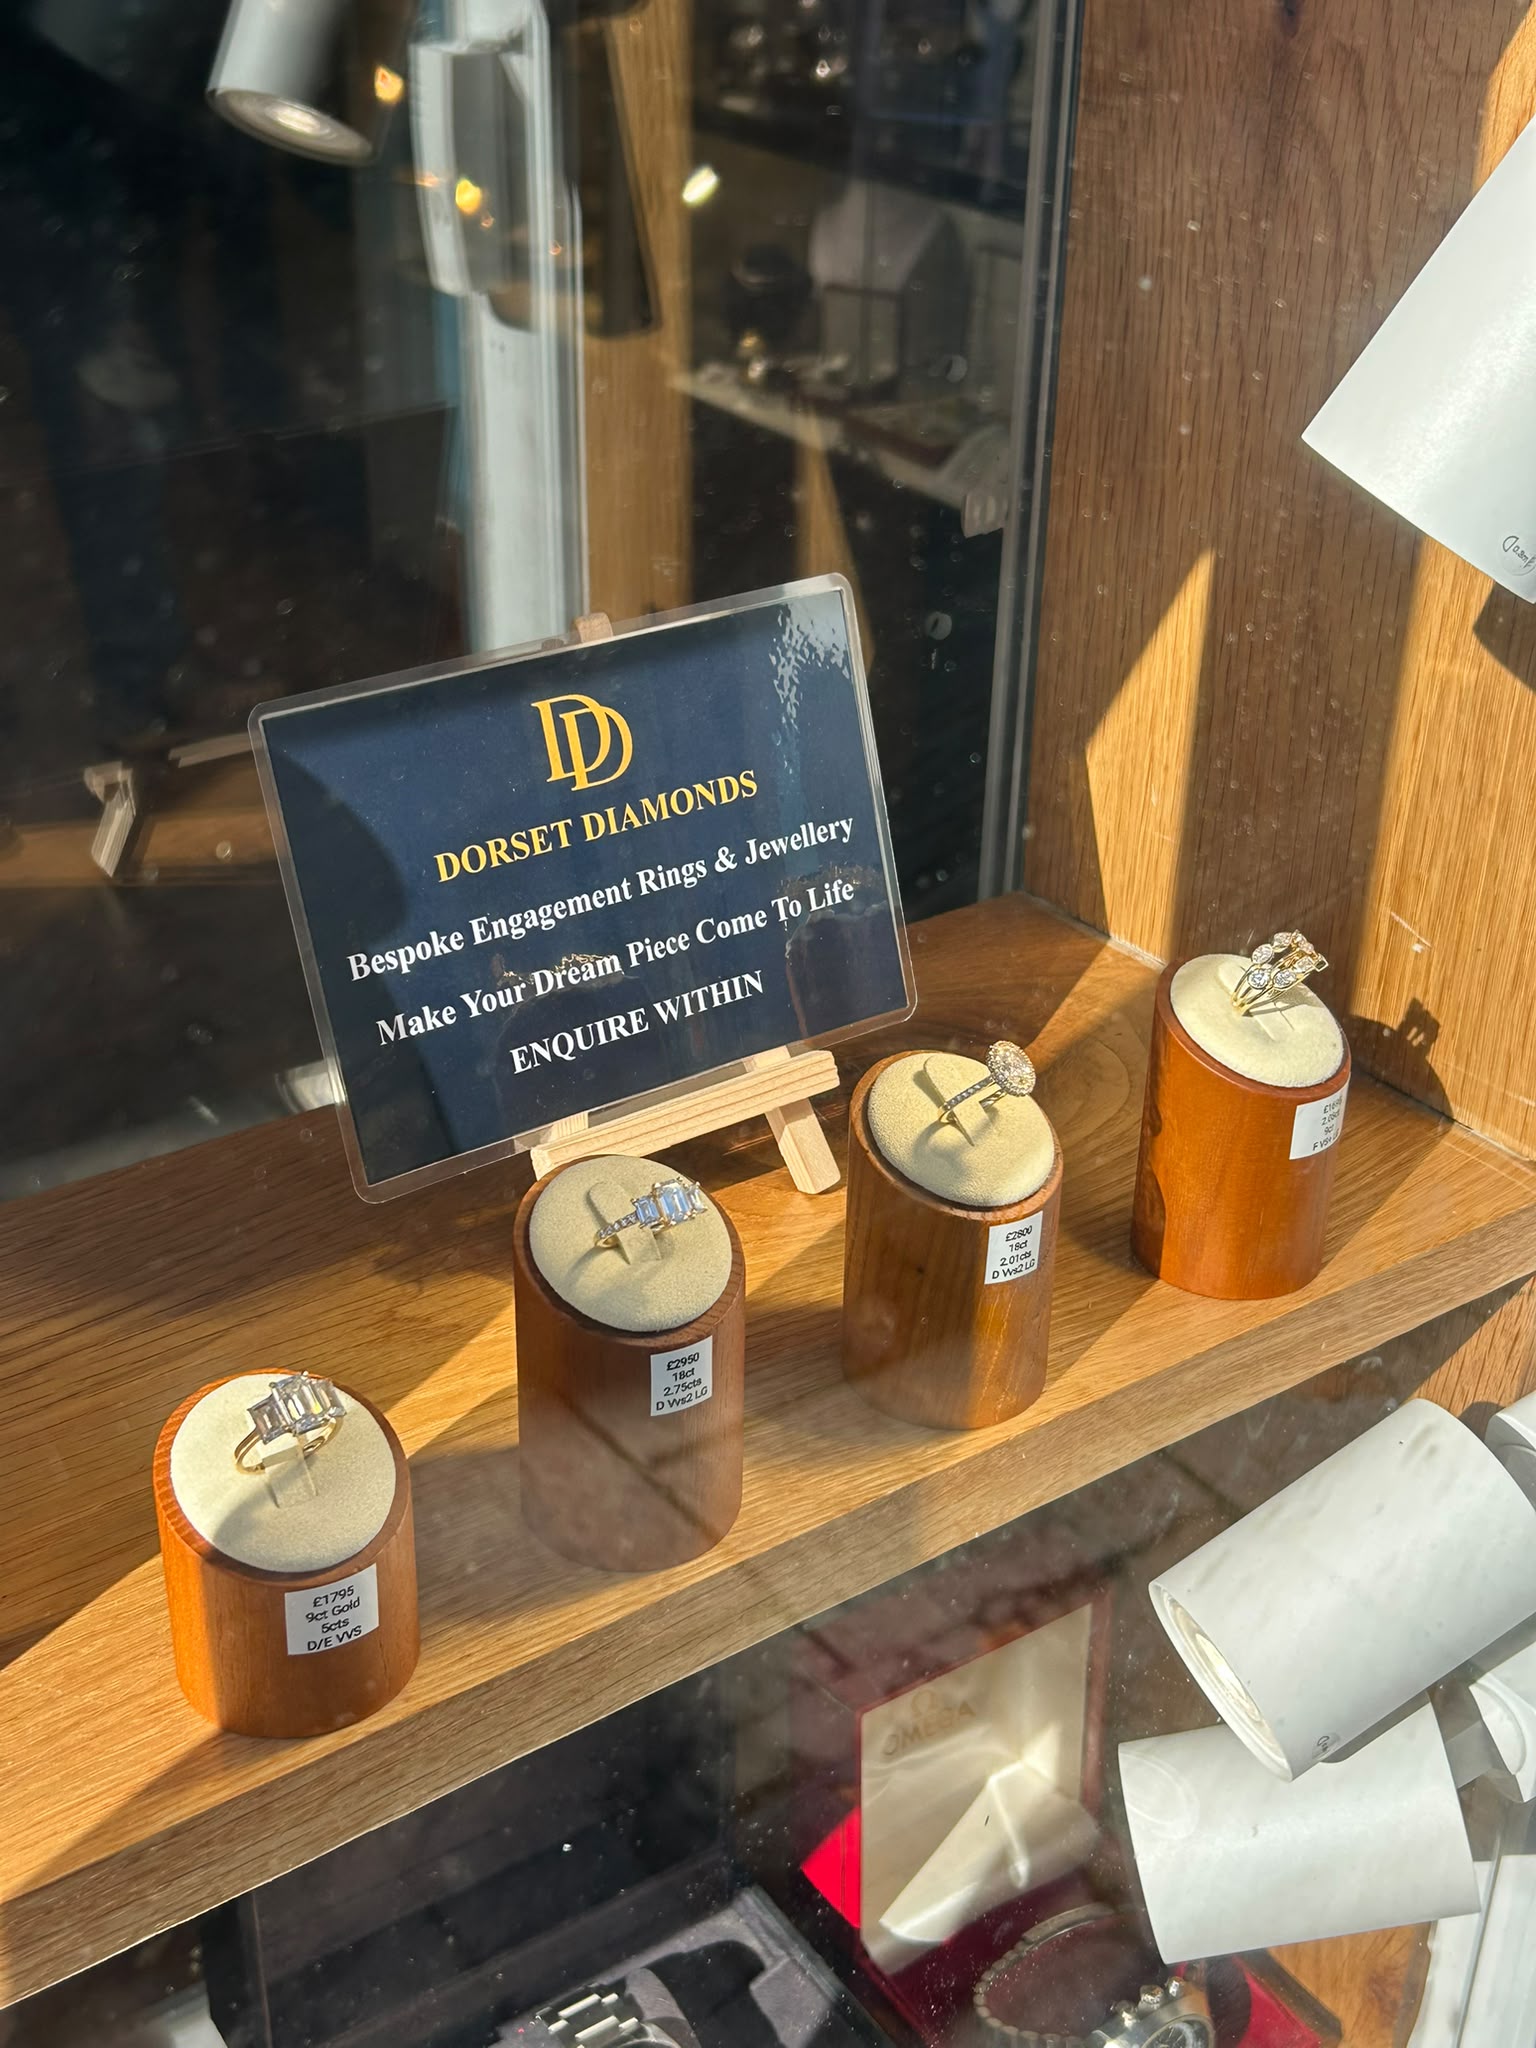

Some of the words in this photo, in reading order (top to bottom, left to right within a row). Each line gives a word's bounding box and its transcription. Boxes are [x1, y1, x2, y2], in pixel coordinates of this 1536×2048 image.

[433, 818, 573, 883] DORSET
[580, 769, 758, 842] DIAMONDS
[347, 930, 465, 982] Bespoke
[468, 877, 633, 945] Engagement
[635, 859, 708, 896] Rings
[714, 846, 738, 873] &
[745, 818, 854, 865] Jewellery
[375, 1004, 457, 1046] Make
[459, 982, 527, 1019] Your
[529, 953, 622, 997] Dream
[625, 932, 691, 968] Piece
[695, 909, 768, 945] Come
[771, 896, 801, 924] To
[806, 879, 855, 913] Life
[509, 1007, 649, 1075] ENQUIRE
[653, 970, 764, 1026] WITHIN
[1005, 1225, 1033, 1242] £2800
[992, 1270, 1000, 1279] D
[666, 1352, 700, 1371] £2950
[672, 1367, 695, 1382] 18ct
[656, 1401, 665, 1411] D
[695, 1386, 708, 1399] LG
[663, 1378, 702, 1397] 2.75cts
[312, 1585, 355, 1608] £1795
[305, 1610, 329, 1623] 9ct
[331, 1596, 361, 1616] Gold
[307, 1636, 333, 1651] D/E
[336, 1625, 362, 1643] VVS
[321, 1618, 350, 1634] 5cts
